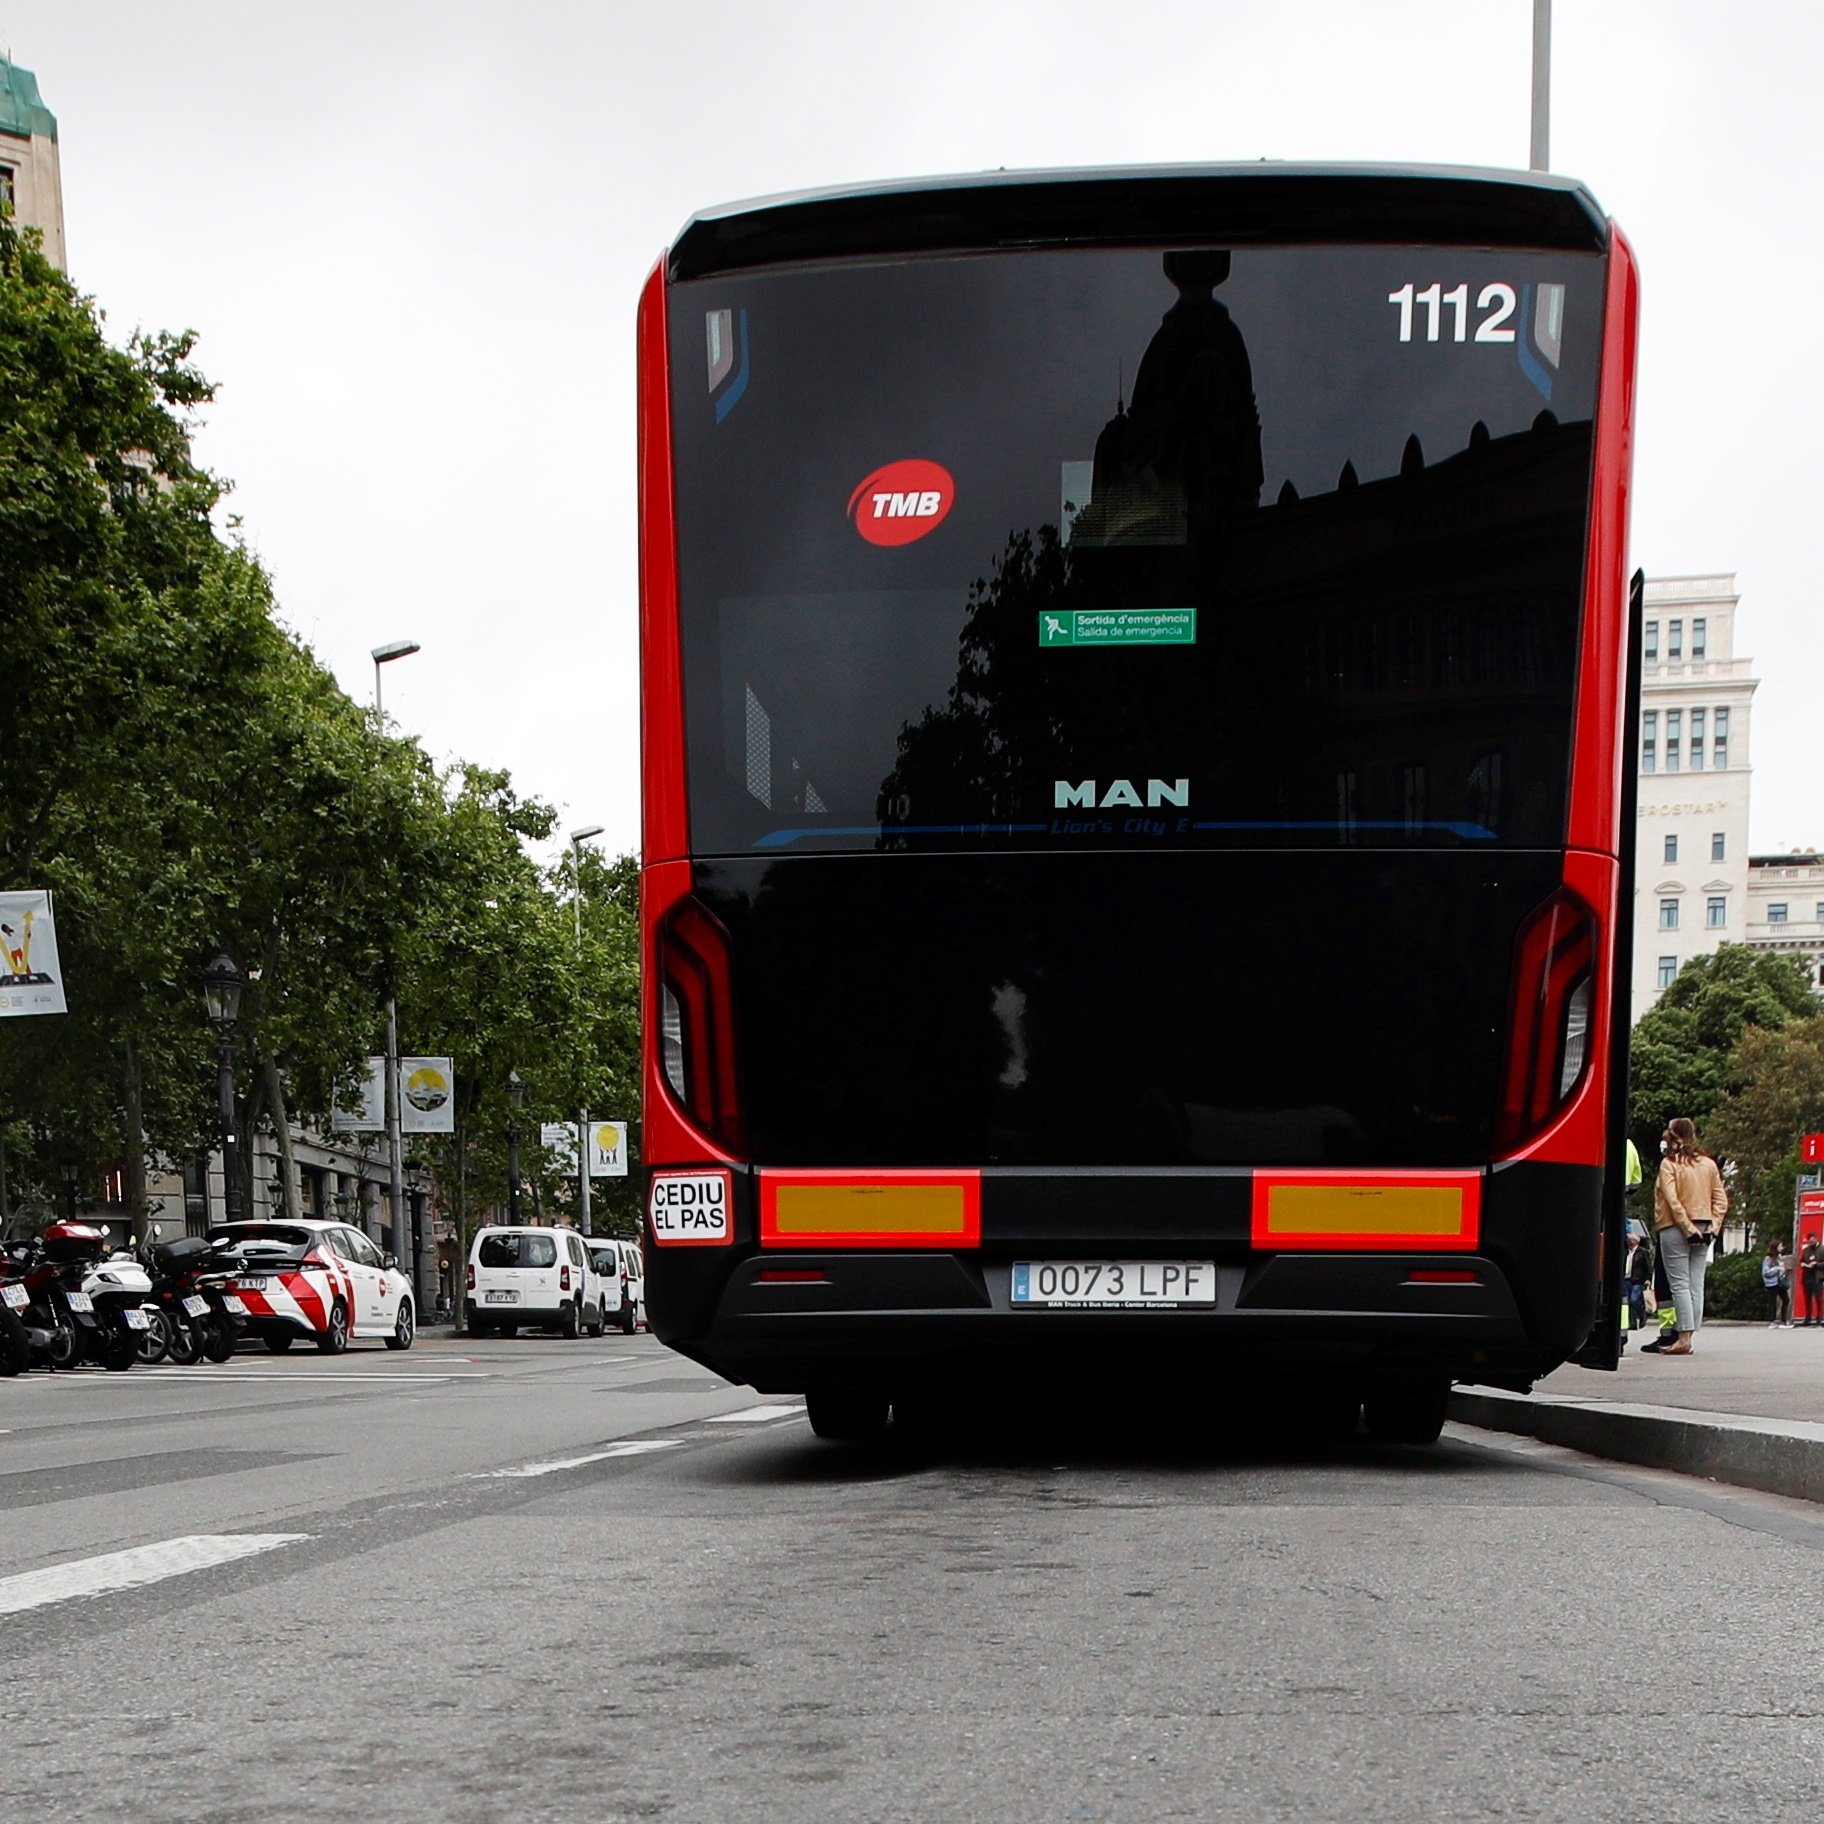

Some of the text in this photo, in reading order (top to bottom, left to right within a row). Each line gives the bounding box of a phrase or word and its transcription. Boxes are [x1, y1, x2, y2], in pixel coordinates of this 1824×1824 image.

[1388, 283, 1517, 343] 1112
[872, 491, 941, 518] TMB
[1077, 613, 1189, 626] Sortida d'emergència
[1077, 627, 1183, 638] Salida de emergencia
[1054, 779, 1189, 808] MAN
[1051, 818, 1189, 836] Lion's City E
[654, 1182, 723, 1206] CEDIU
[655, 1208, 724, 1229] EL PAS
[1017, 1285, 1026, 1295] E
[1038, 1265, 1203, 1296] 0073 LPF
